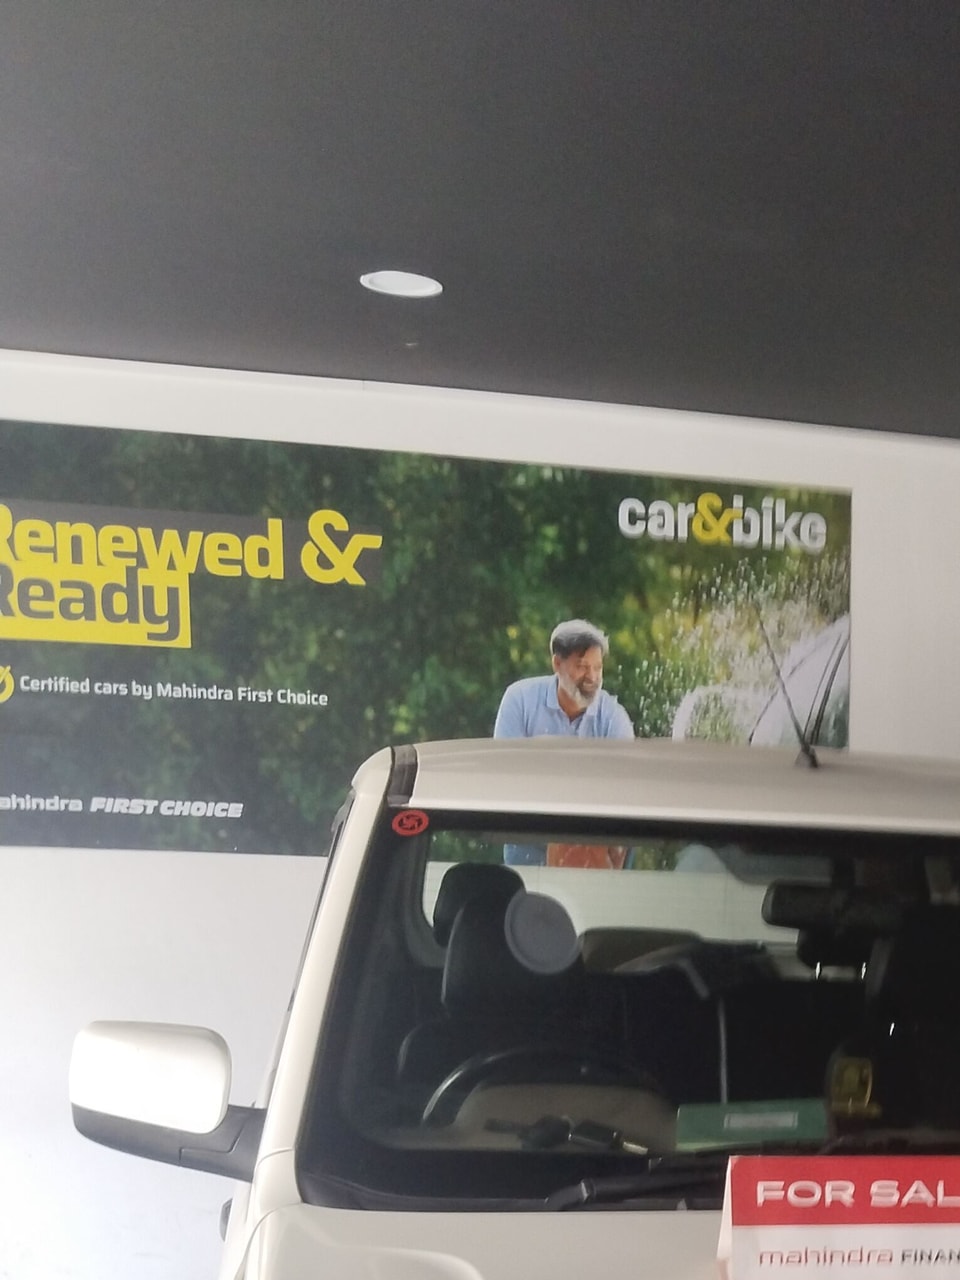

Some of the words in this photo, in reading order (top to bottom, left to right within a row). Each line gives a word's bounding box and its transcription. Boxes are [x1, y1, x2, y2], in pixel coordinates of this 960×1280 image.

[617, 492, 827, 554] car&bike
[301, 509, 383, 587] &
[19, 675, 90, 694] Certified
[94, 680, 128, 696] cars
[131, 680, 152, 700] by
[156, 682, 234, 701] Mahindra
[237, 686, 274, 703] First
[277, 689, 328, 706] Choice
[0, 793, 83, 812] ahindra
[90, 797, 158, 815] FIRST
[159, 800, 244, 818] CHOICE
[756, 1180, 856, 1208] FOR
[758, 1246, 894, 1269] mahindra
